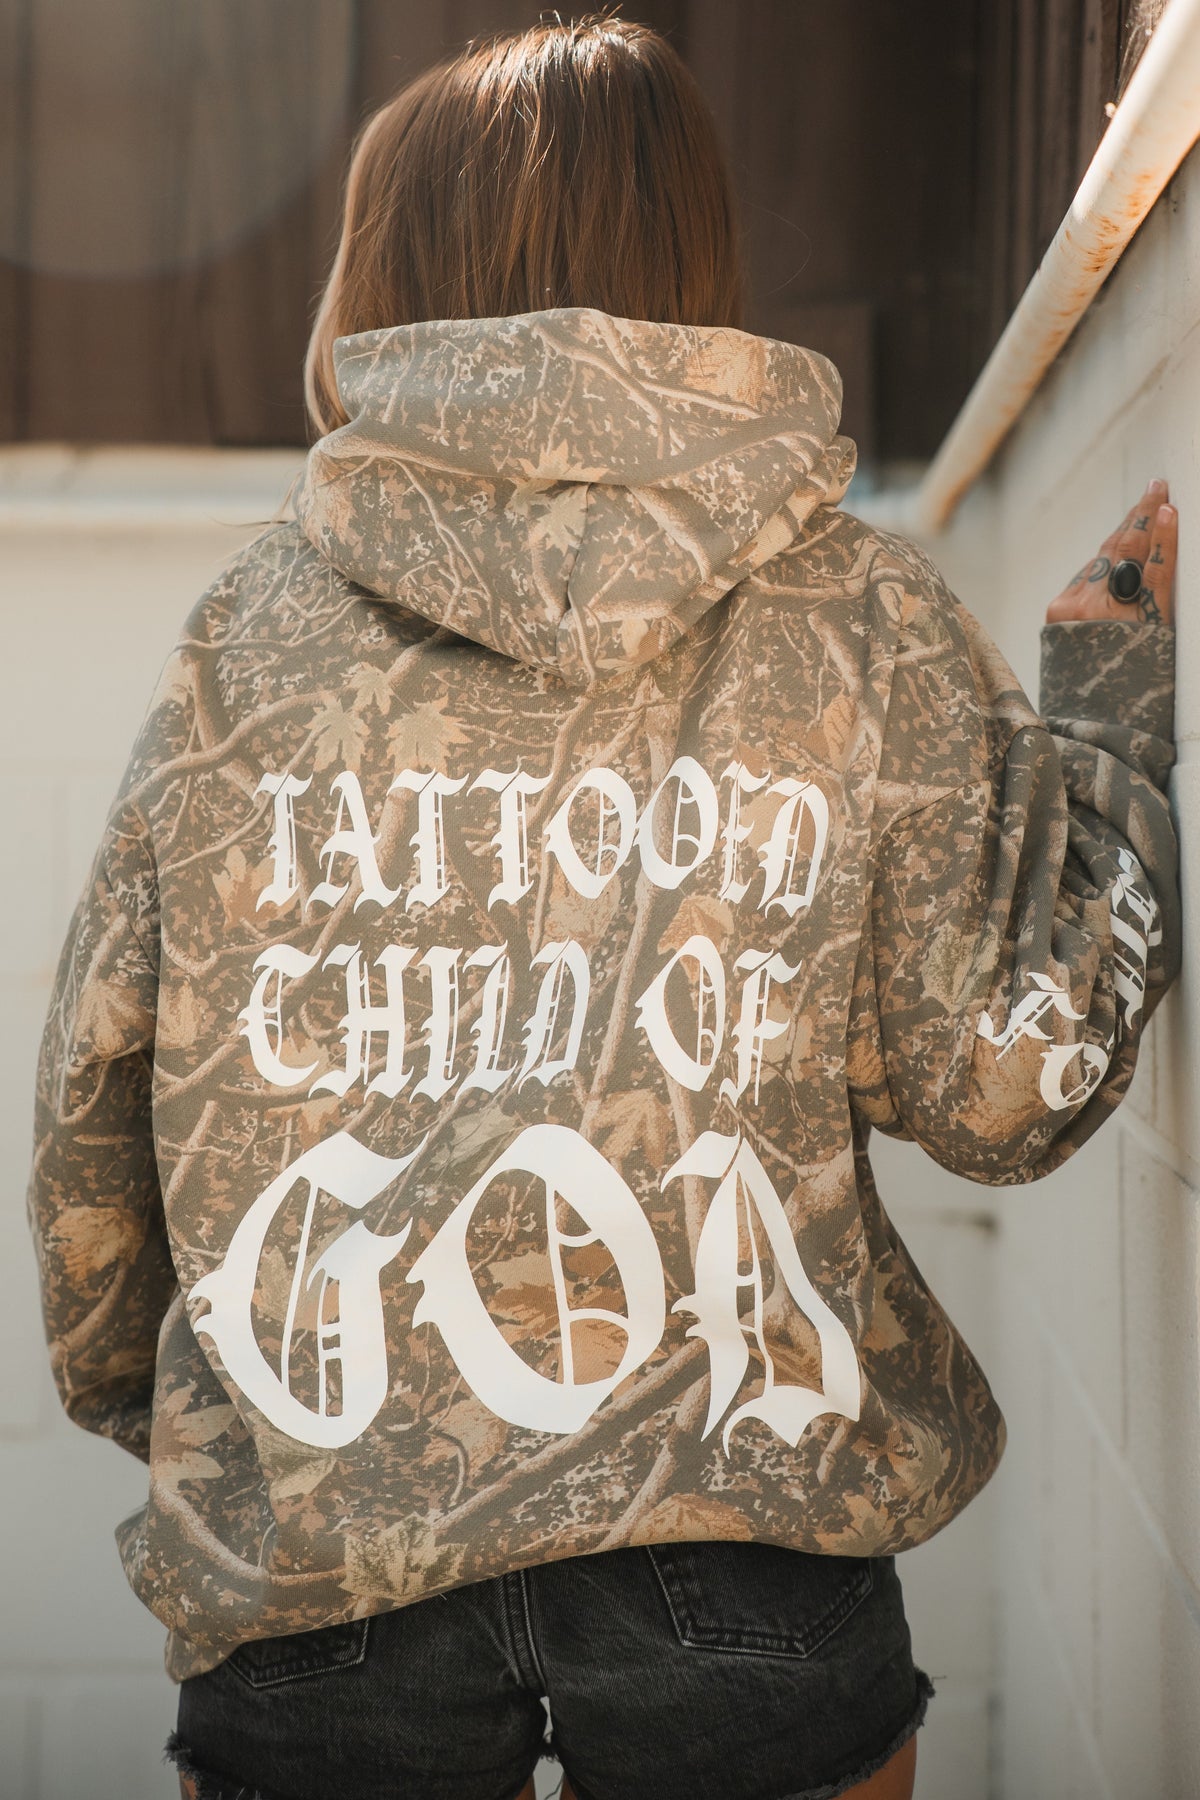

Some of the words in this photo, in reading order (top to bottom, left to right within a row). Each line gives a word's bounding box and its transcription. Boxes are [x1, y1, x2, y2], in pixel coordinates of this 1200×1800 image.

[253, 755, 830, 918] TATTOOED
[236, 939, 592, 1103] CHILD
[634, 934, 803, 1107] OF
[187, 1123, 861, 1460] GOD
